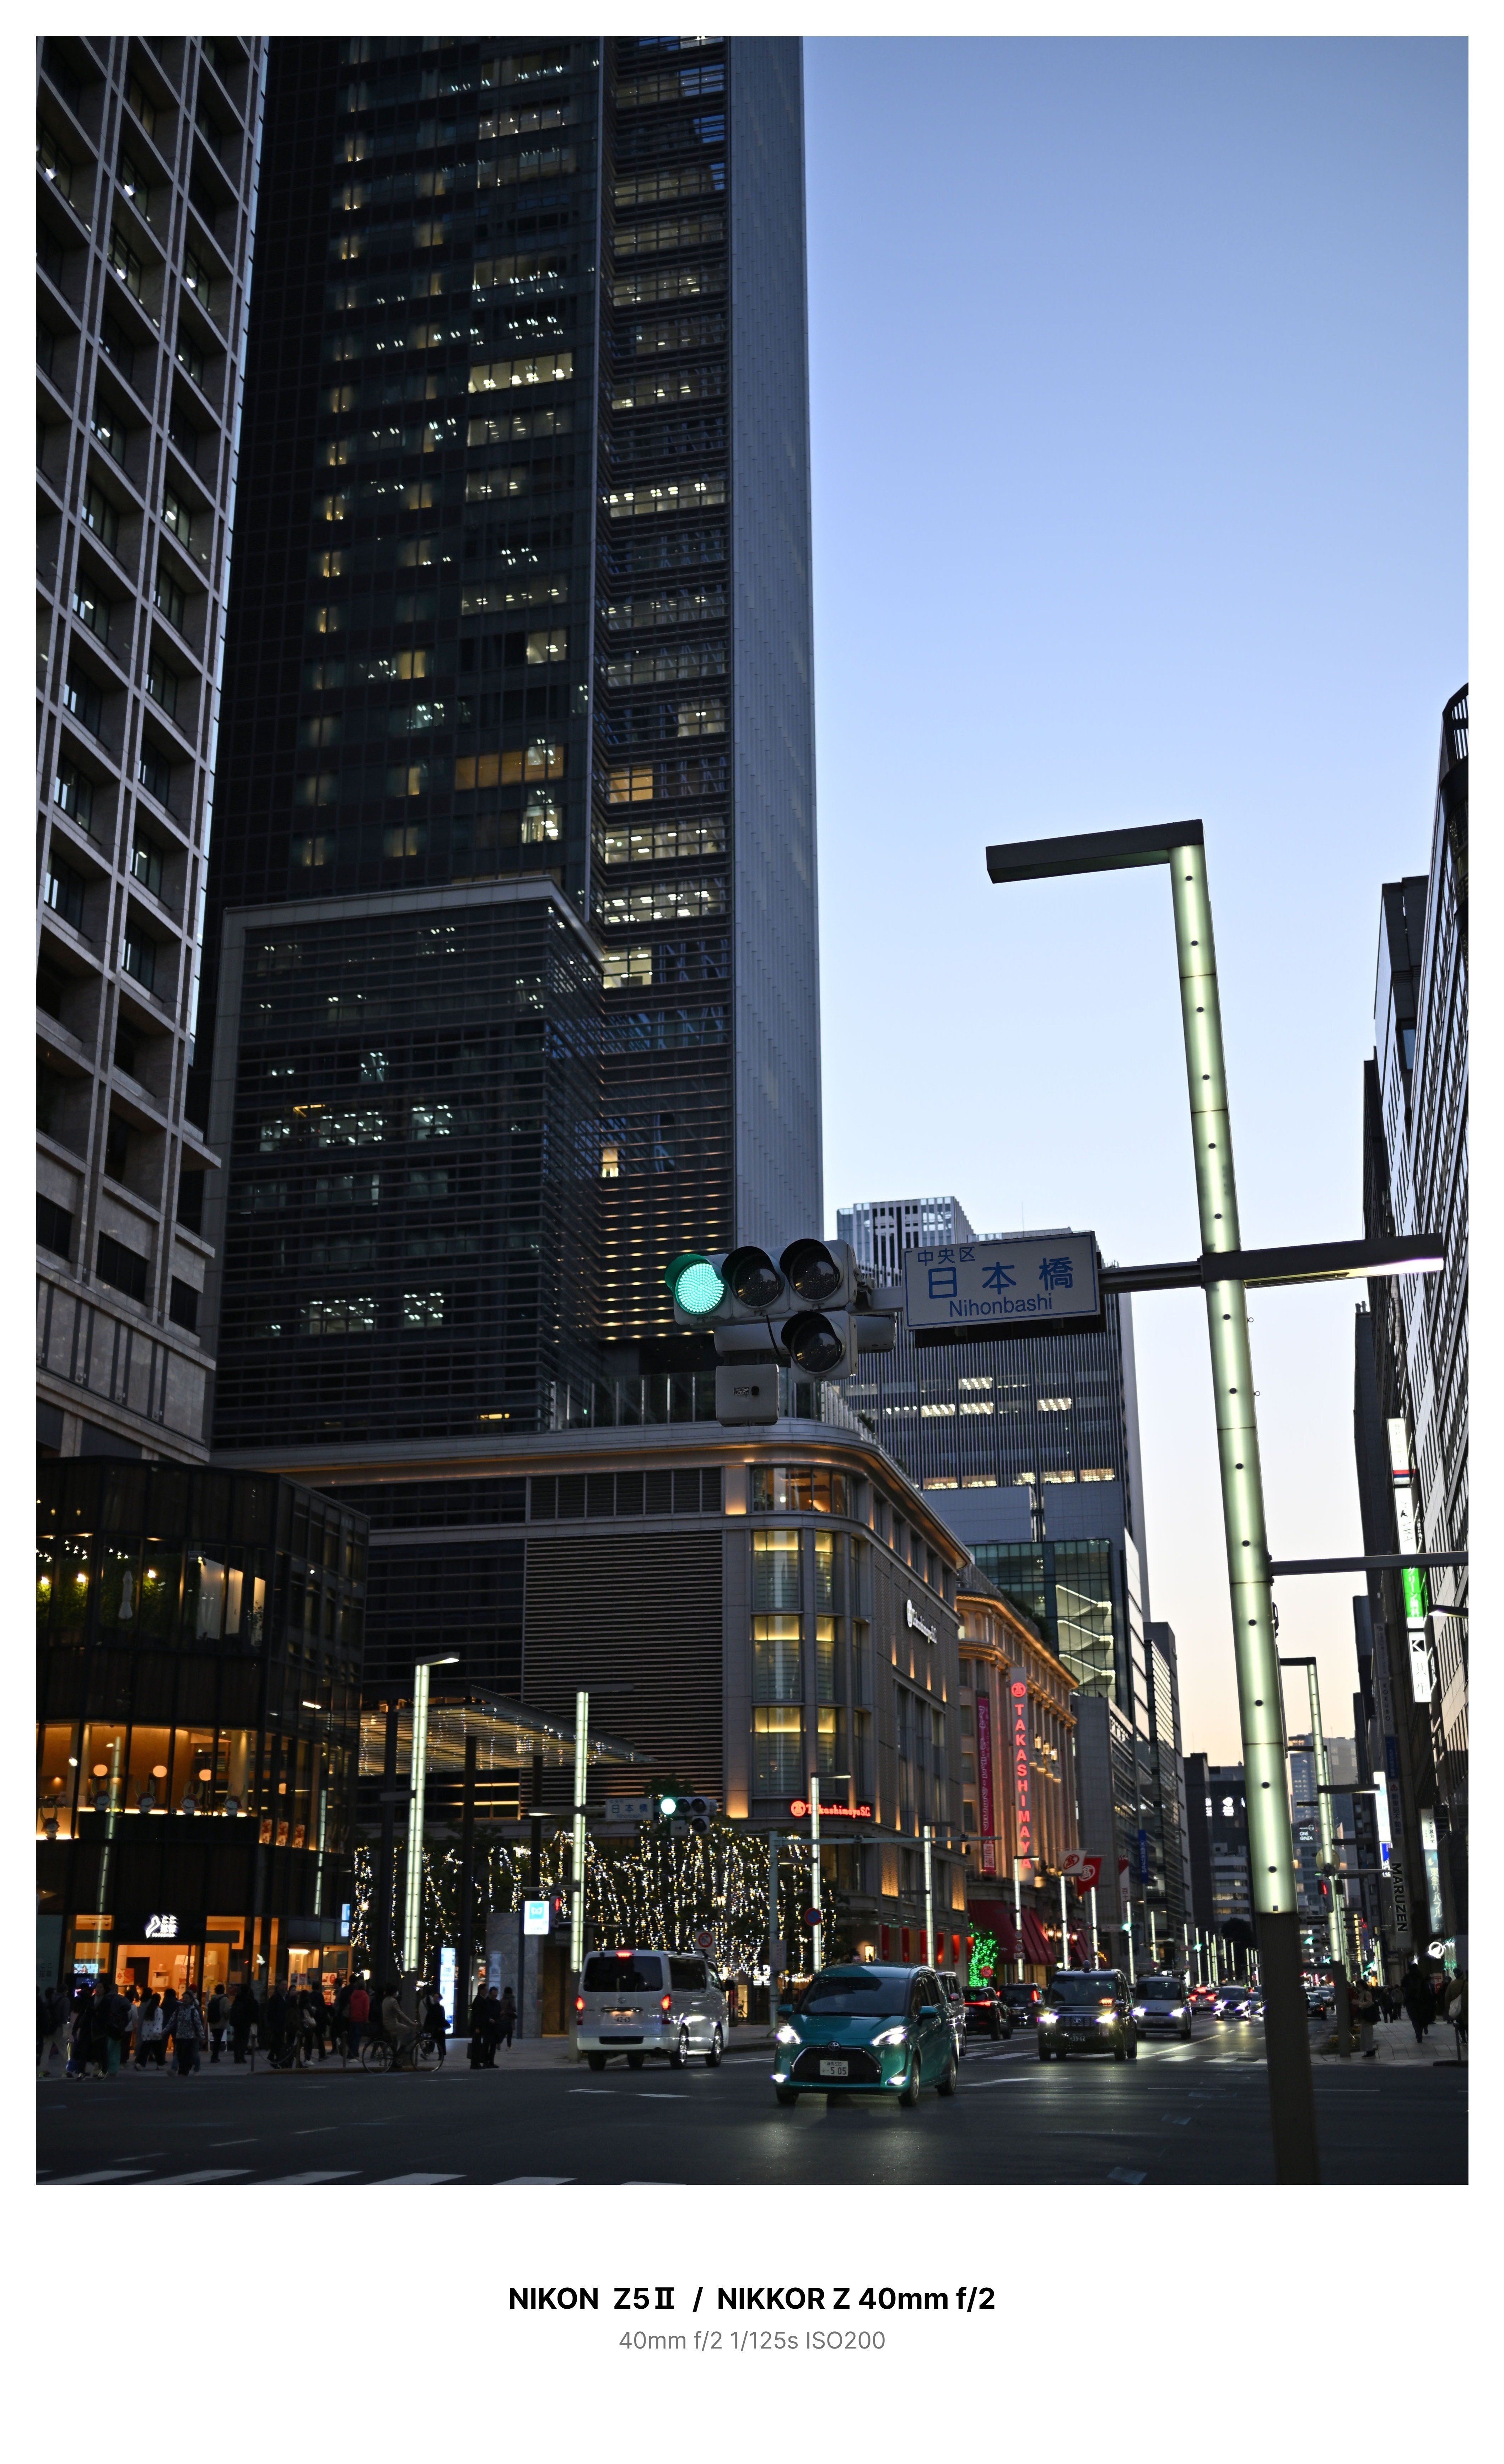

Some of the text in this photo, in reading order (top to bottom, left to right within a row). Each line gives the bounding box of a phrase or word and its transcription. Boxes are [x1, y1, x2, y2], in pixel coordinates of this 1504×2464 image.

[918, 1246, 975, 1266] 中央区
[928, 1257, 1073, 1299] 日本橋
[950, 1294, 1052, 1317] Nihonbashi
[1015, 1704, 1031, 1869] TAKASHIMAYA
[612, 1804, 647, 1813] 日本橋
[806, 1804, 860, 1818] Tkashimaya
[1391, 1863, 1408, 1932] MARUZEN
